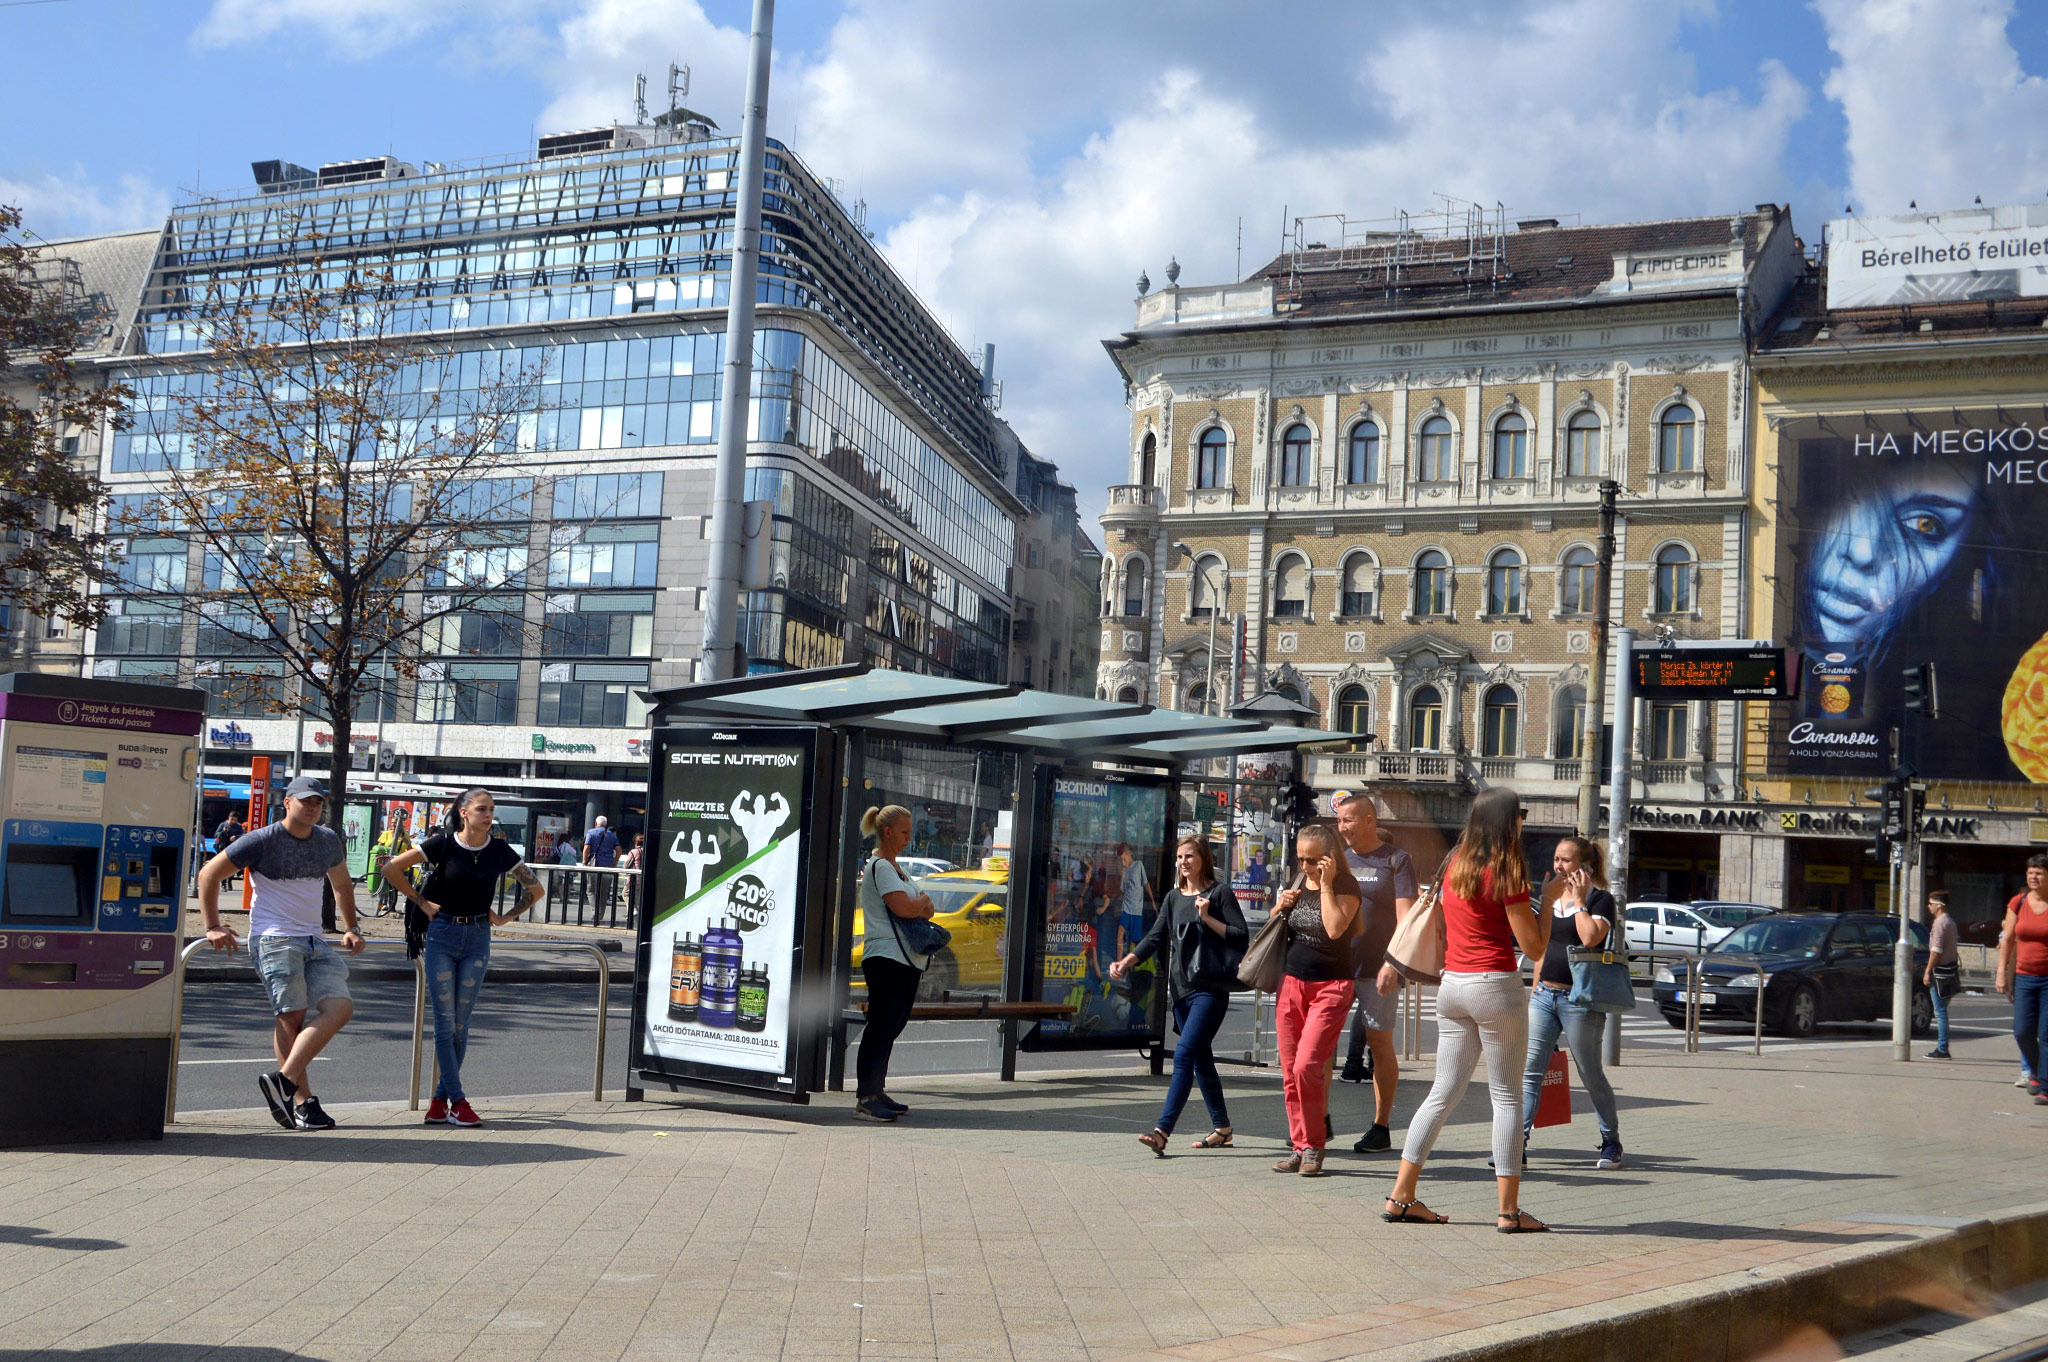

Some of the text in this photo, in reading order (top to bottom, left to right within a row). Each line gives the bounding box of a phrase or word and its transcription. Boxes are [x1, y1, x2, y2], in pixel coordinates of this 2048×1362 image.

[1861, 241, 1971, 268] Bérelhető
[1854, 432, 1900, 456] HA
[1660, 661, 1685, 670] Móricz
[1700, 661, 1723, 669] körtér
[1726, 661, 1734, 669] M
[1812, 662, 1858, 675] Caramoon
[1660, 669, 1679, 678] Széll
[1681, 669, 1708, 678] Kálmán
[1710, 669, 1722, 678] tér
[1724, 669, 1732, 677] M
[1720, 677, 1728, 685] M
[81, 702, 109, 714] Jegyek
[122, 706, 155, 717] bérletek
[81, 714, 152, 728] Tickets and passes
[210, 727, 252, 746] Regus
[712, 732, 737, 740] JCDecaux
[1788, 722, 1879, 745] Caramoon
[545, 741, 597, 755] Groupama
[1796, 749, 1819, 757] HOLD
[1821, 748, 1878, 759] VONZÁSÁBAN
[671, 753, 797, 767] SCITEC NUTRITION
[1055, 780, 1108, 797] DECATHLON
[669, 799, 725, 812] VÁLTOZZ TE IS
[1600, 805, 1761, 826] Rffeisen BANK
[12, 822, 19, 836] 1
[1800, 812, 1976, 836] Raiffei ANK
[110, 828, 121, 841] 2
[725, 901, 769, 927] AKCIÓ
[1047, 922, 1089, 933] GYEREKPÓLÓ
[1047, 933, 1092, 943] VAGY NADRÁG
[1047, 958, 1077, 976] 1290
[739, 991, 766, 1000] BCAA
[653, 1024, 674, 1033] AKCIÓ
[1544, 1070, 1563, 1079] ffice
